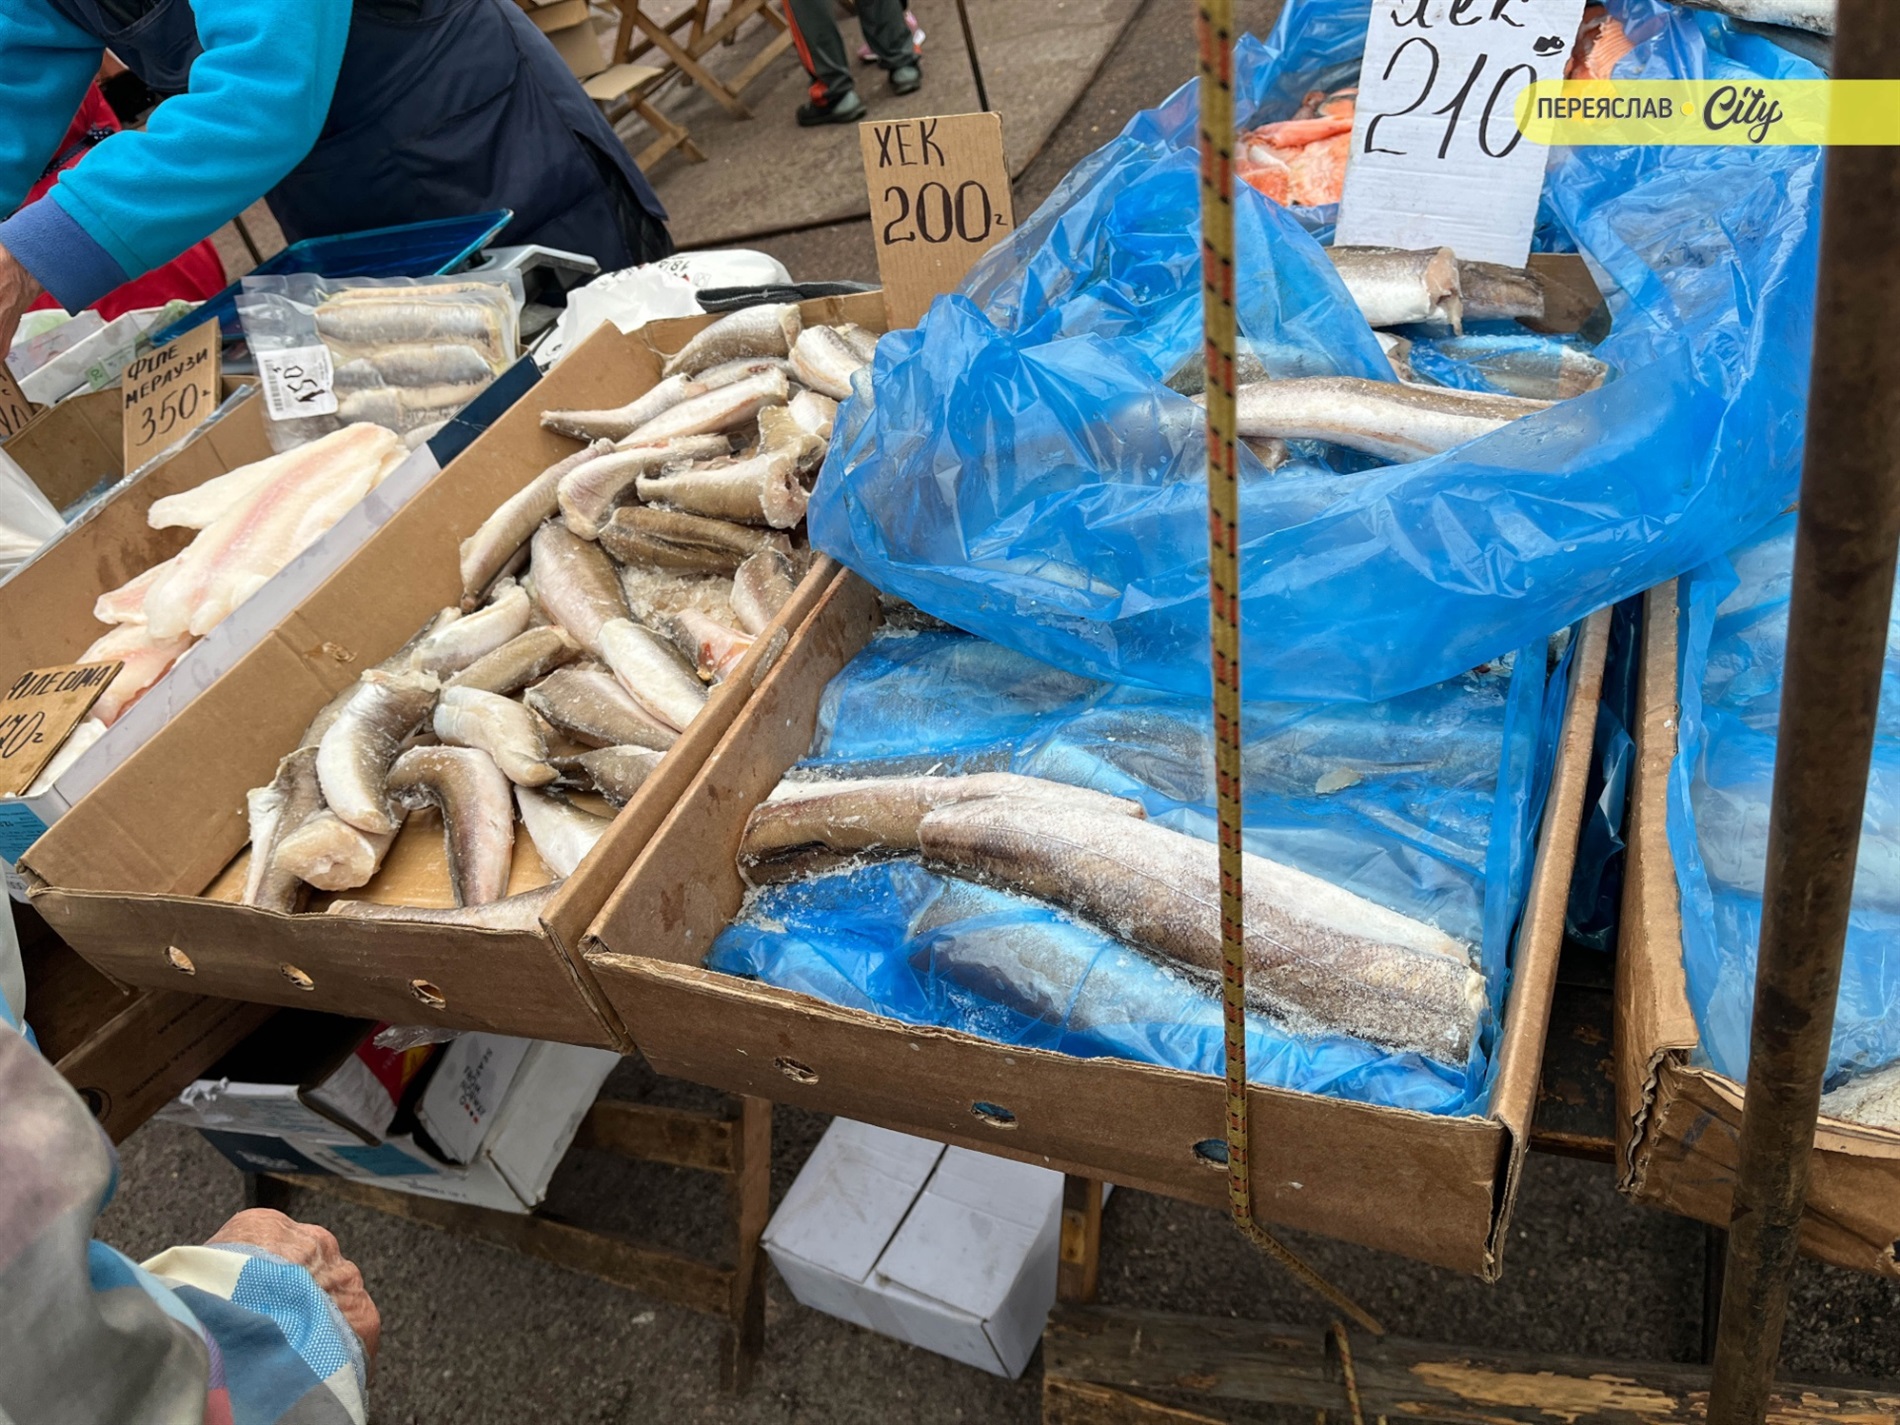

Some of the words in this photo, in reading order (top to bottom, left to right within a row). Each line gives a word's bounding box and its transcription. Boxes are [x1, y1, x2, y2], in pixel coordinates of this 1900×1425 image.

[874, 118, 945, 168] ХЕК
[126, 348, 208, 409] МЕРЛУЗИ
[128, 344, 179, 380] ФІЛЕ
[54, 665, 112, 692] СОМА
